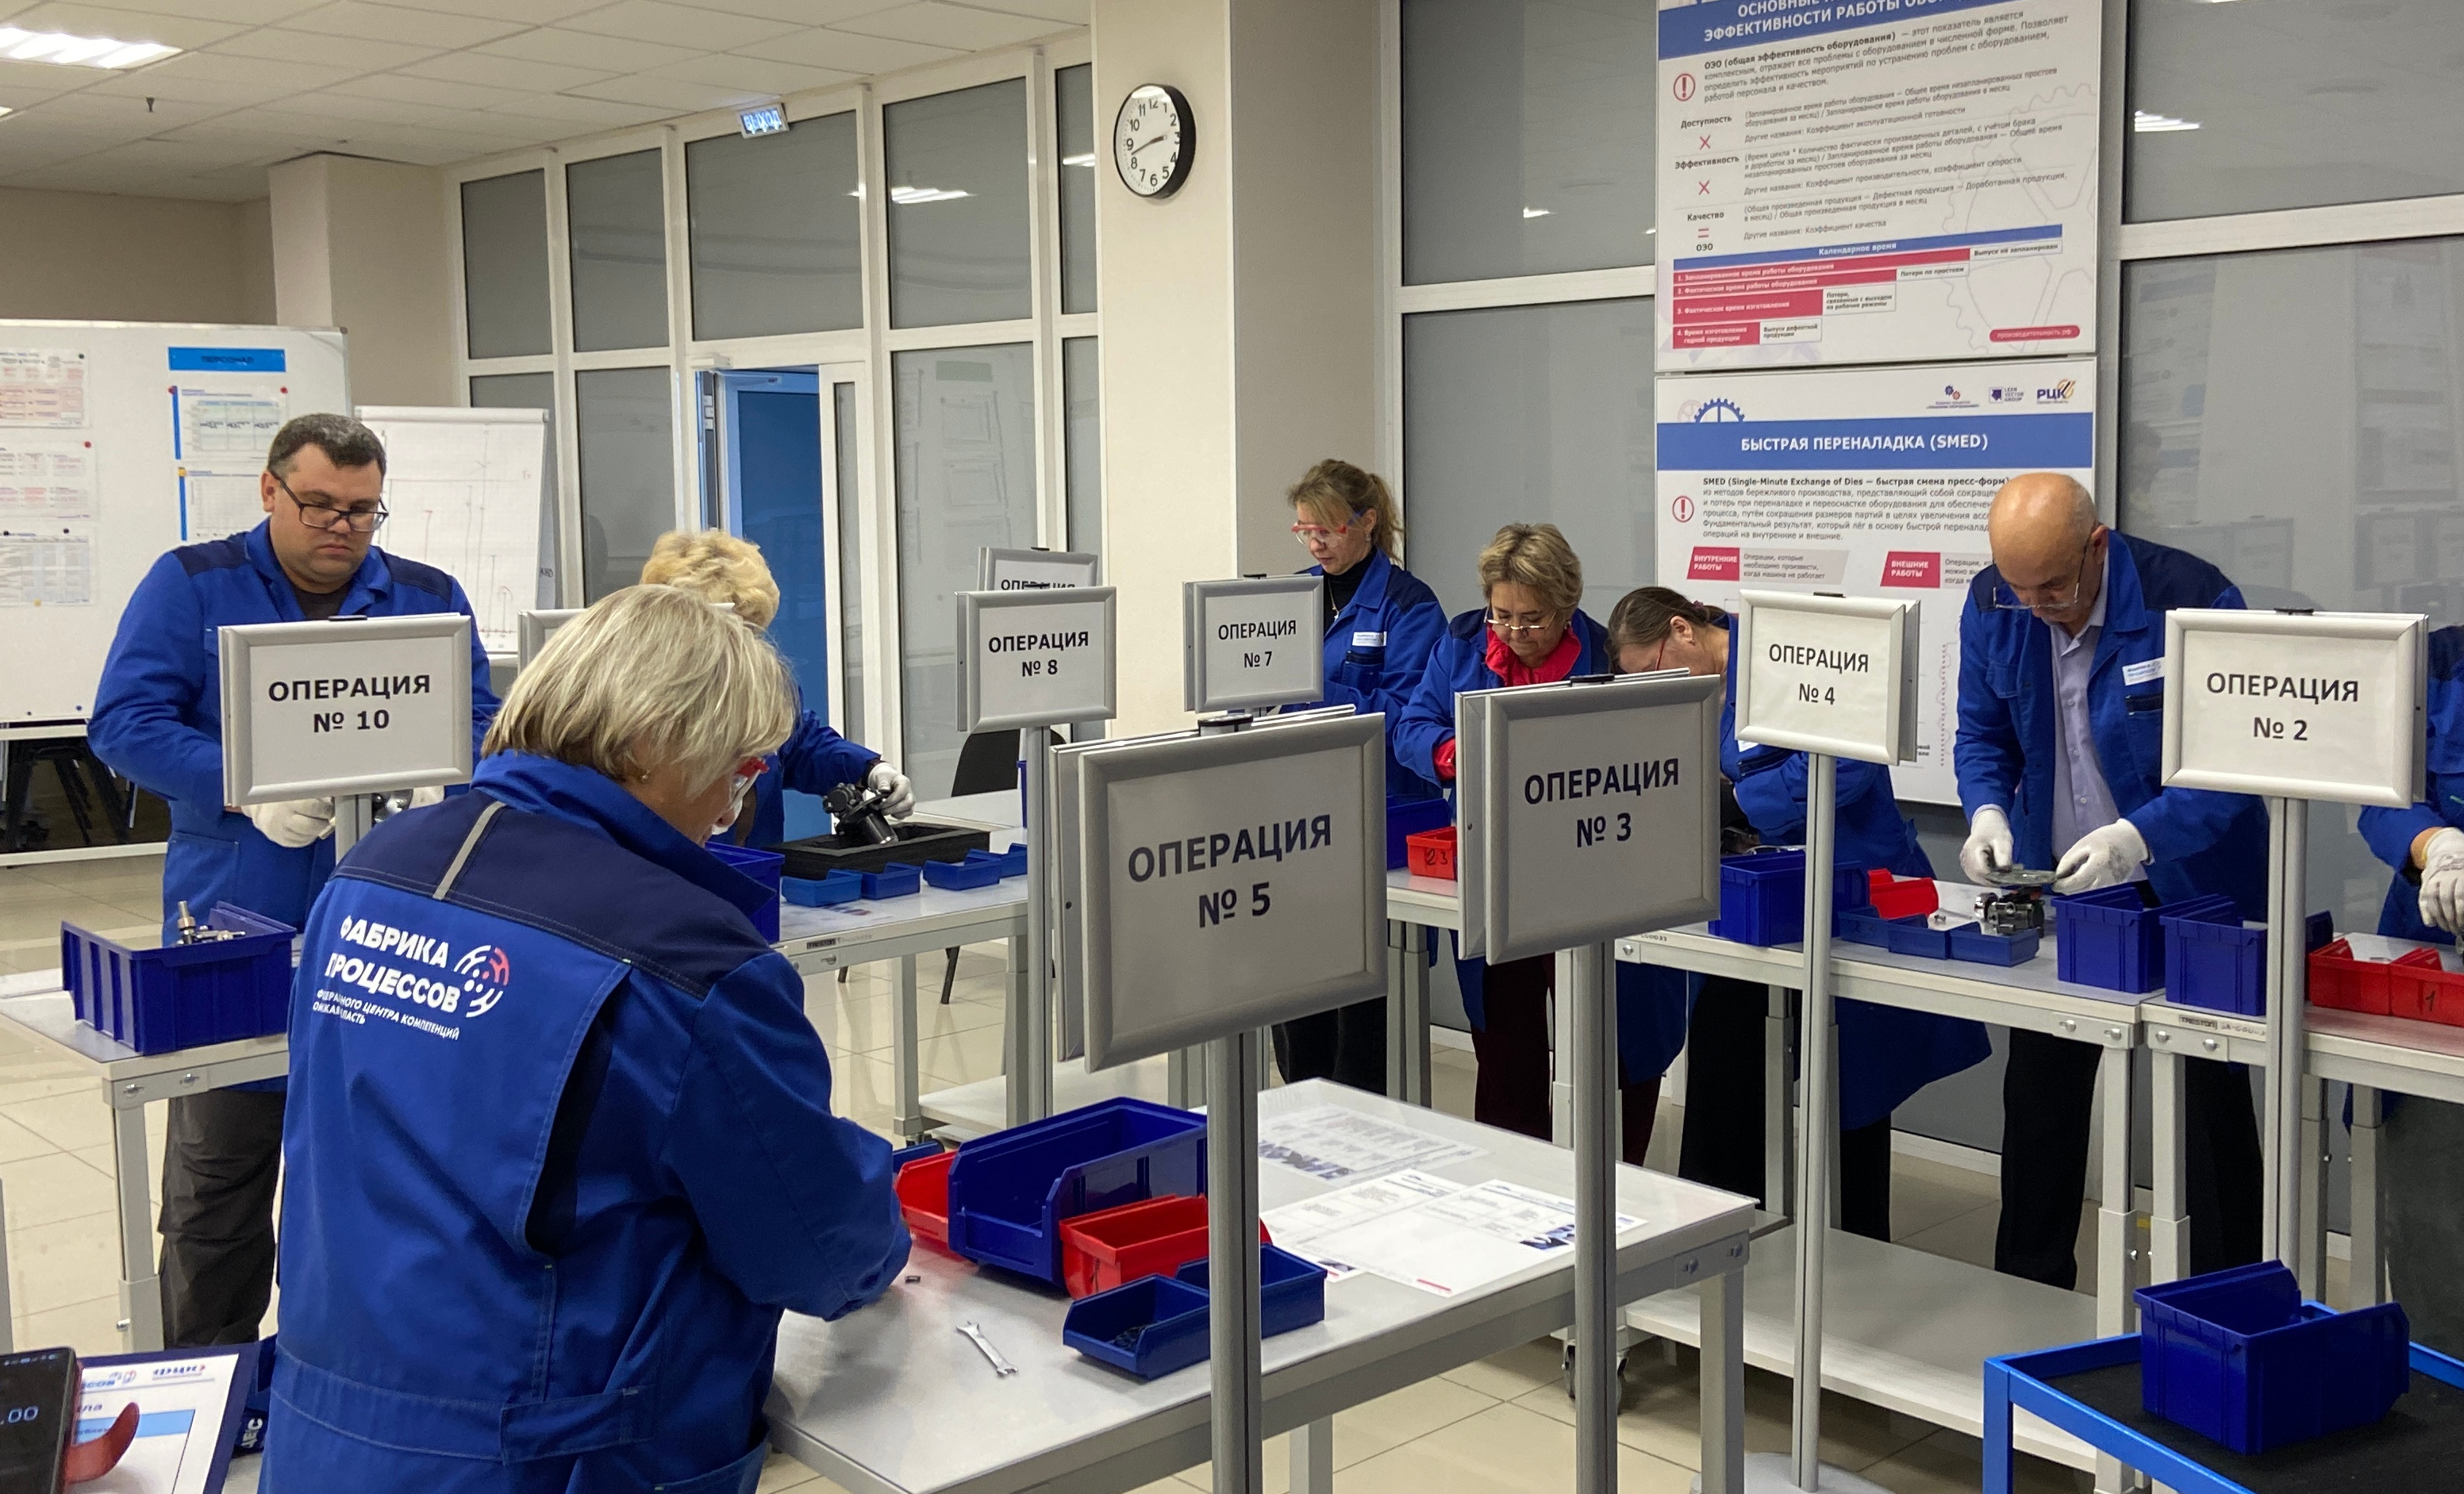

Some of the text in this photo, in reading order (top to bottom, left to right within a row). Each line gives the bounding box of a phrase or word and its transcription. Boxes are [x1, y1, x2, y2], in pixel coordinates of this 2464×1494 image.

[1704, 0, 1900, 42] ЭФФЕКТИВНОСТИ РАБОТЫ
[1148, 97, 1159, 109] 12
[1163, 103, 1167, 113] 1
[1139, 104, 1146, 117] 11
[1130, 119, 1140, 132] 10
[1170, 113, 1177, 126] 2
[1681, 116, 1732, 129] Доступность
[1127, 138, 1133, 151] 9
[1174, 132, 1180, 144] 3
[1131, 157, 1137, 169] 8
[1170, 152, 1177, 164] 4
[1675, 156, 1739, 170] Эффективность
[1140, 169, 1146, 182] 7
[1163, 166, 1170, 179] 5
[1150, 174, 1158, 186] 6
[1687, 211, 1724, 221] Качество
[1819, 243, 1897, 255] Календарное время
[2036, 389, 2066, 400] РЦК
[1741, 434, 1989, 452] БЫСТРАЯ ПЕРЕНАЛАДКА (SMED)
[1728, 478, 1788, 486] (Single-Minute
[1791, 478, 1831, 487] Exchange
[1876, 478, 1913, 486] быстрая
[1857, 489, 1927, 497] представляющий
[1869, 500, 1927, 509] оборудования
[1703, 520, 1771, 528] Фундаментальный
[1817, 521, 1850, 530] который
[1907, 522, 1940, 532] быстрой
[1218, 620, 1297, 640] ОПЕРАЦИЯ
[988, 631, 1089, 653] ОПЕРАЦИЯ
[1244, 651, 1273, 669] № 7
[1769, 643, 1869, 674] ОПЕРАЦИЯ
[1021, 659, 1058, 678] № 8
[268, 674, 430, 702] ОПЕРАЦИЯ
[1799, 682, 1836, 705] № 4
[2207, 672, 2358, 705] ОПЕРАЦИЯ
[313, 709, 390, 733] № 10
[2254, 716, 2308, 741] № 2
[1524, 758, 1678, 805] ОПЕРАЦИЯ
[1577, 812, 1632, 848] № 3
[1128, 814, 1331, 882] ОПЕРАЦИЯ
[1199, 881, 1270, 928] № 5
[340, 915, 449, 968] ФАБРИКА
[325, 952, 461, 1013] ПРОЦЕССОВ
[362, 1001, 399, 1022] ЦЕНТРА
